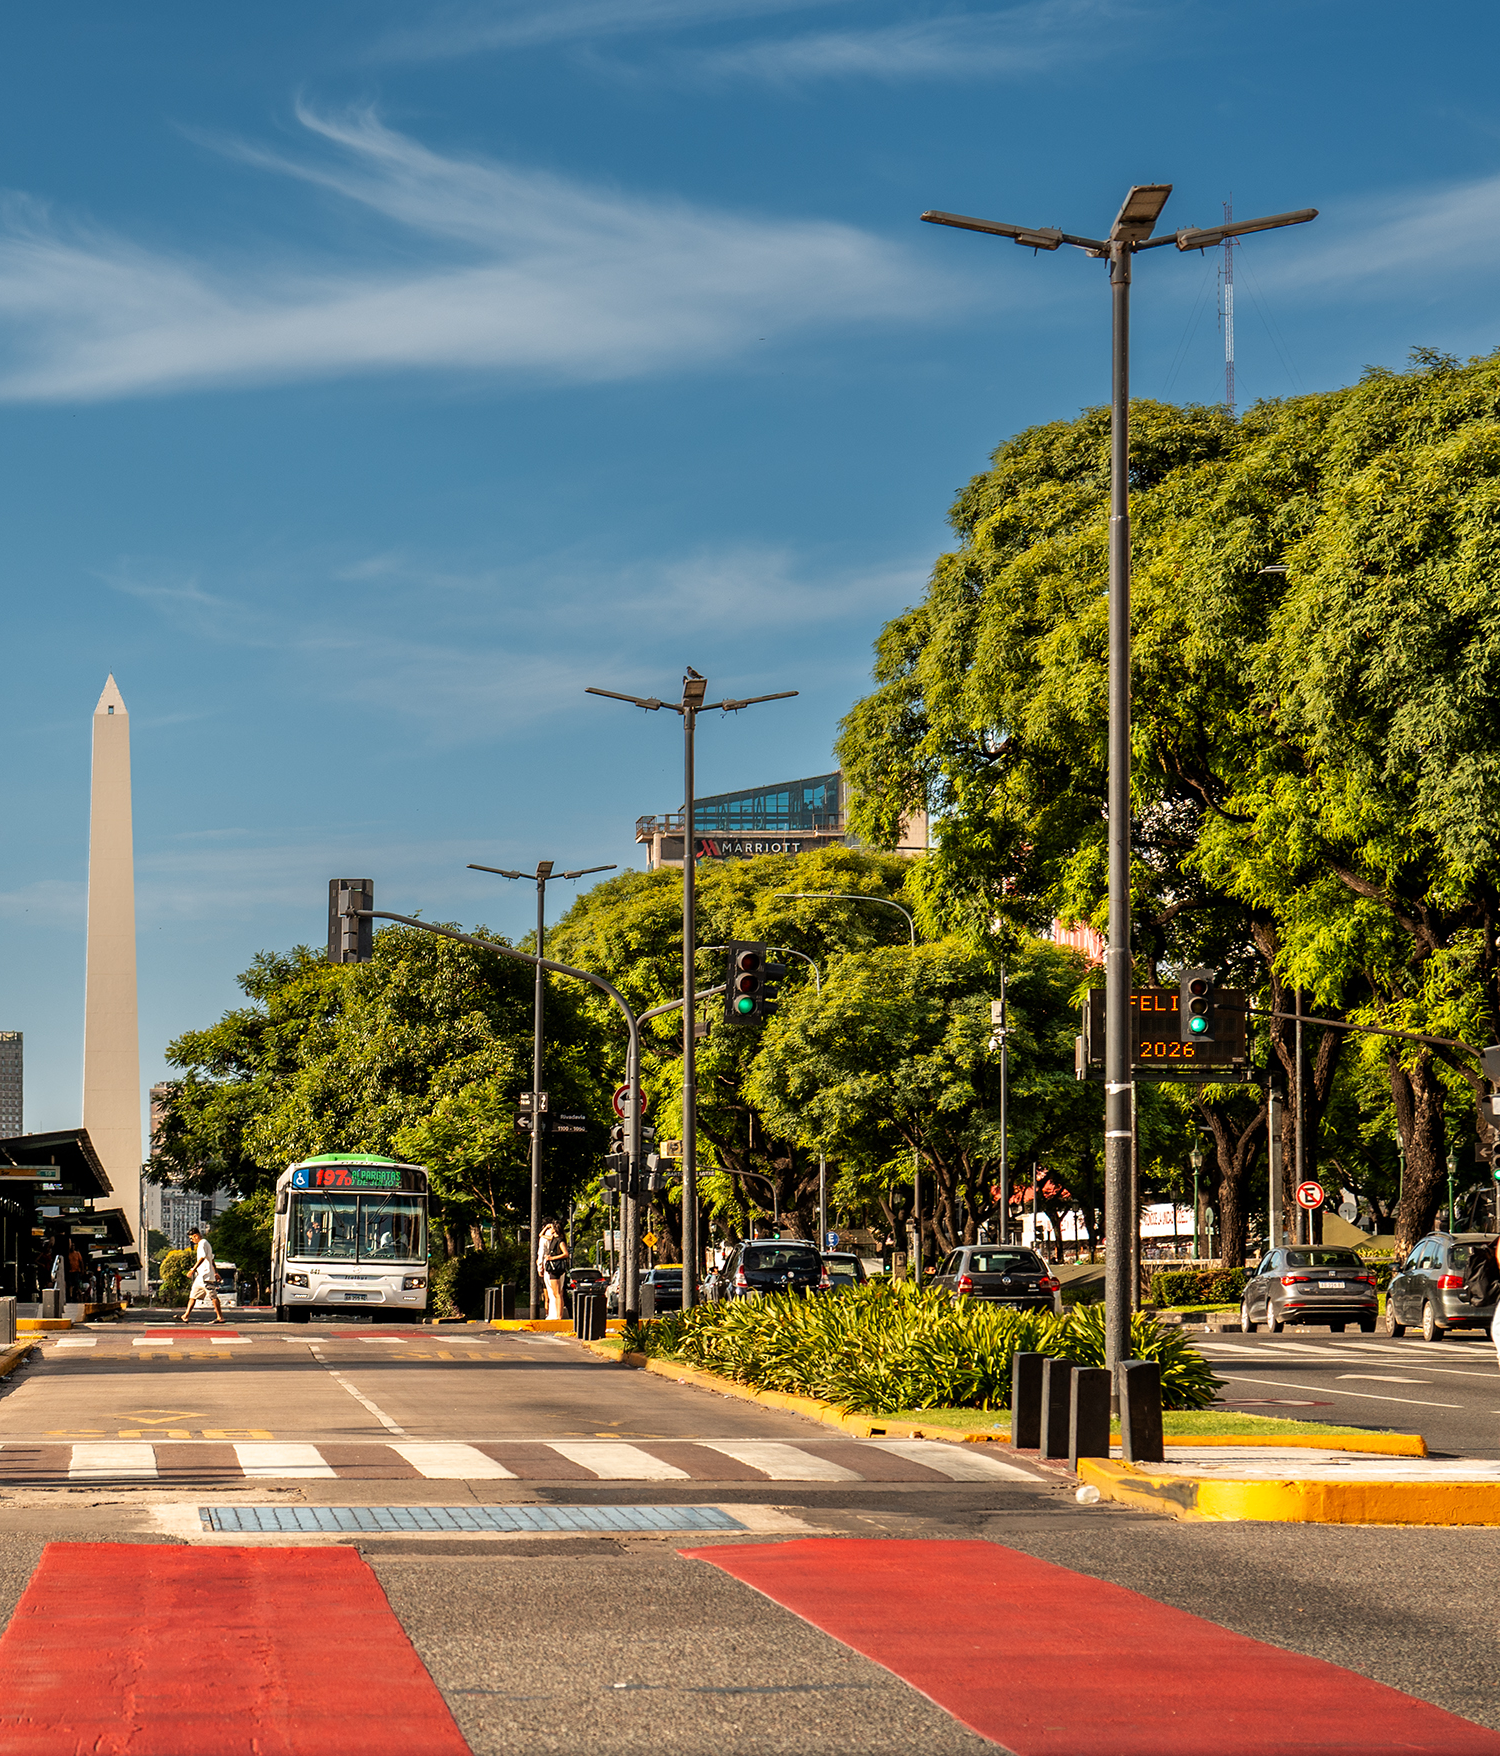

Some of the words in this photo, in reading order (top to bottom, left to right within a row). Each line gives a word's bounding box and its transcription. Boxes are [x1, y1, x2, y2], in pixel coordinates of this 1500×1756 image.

[722, 842, 801, 854] MARRIOTT
[1130, 995, 1179, 1012] FELI
[1140, 1041, 1196, 1058] 2026
